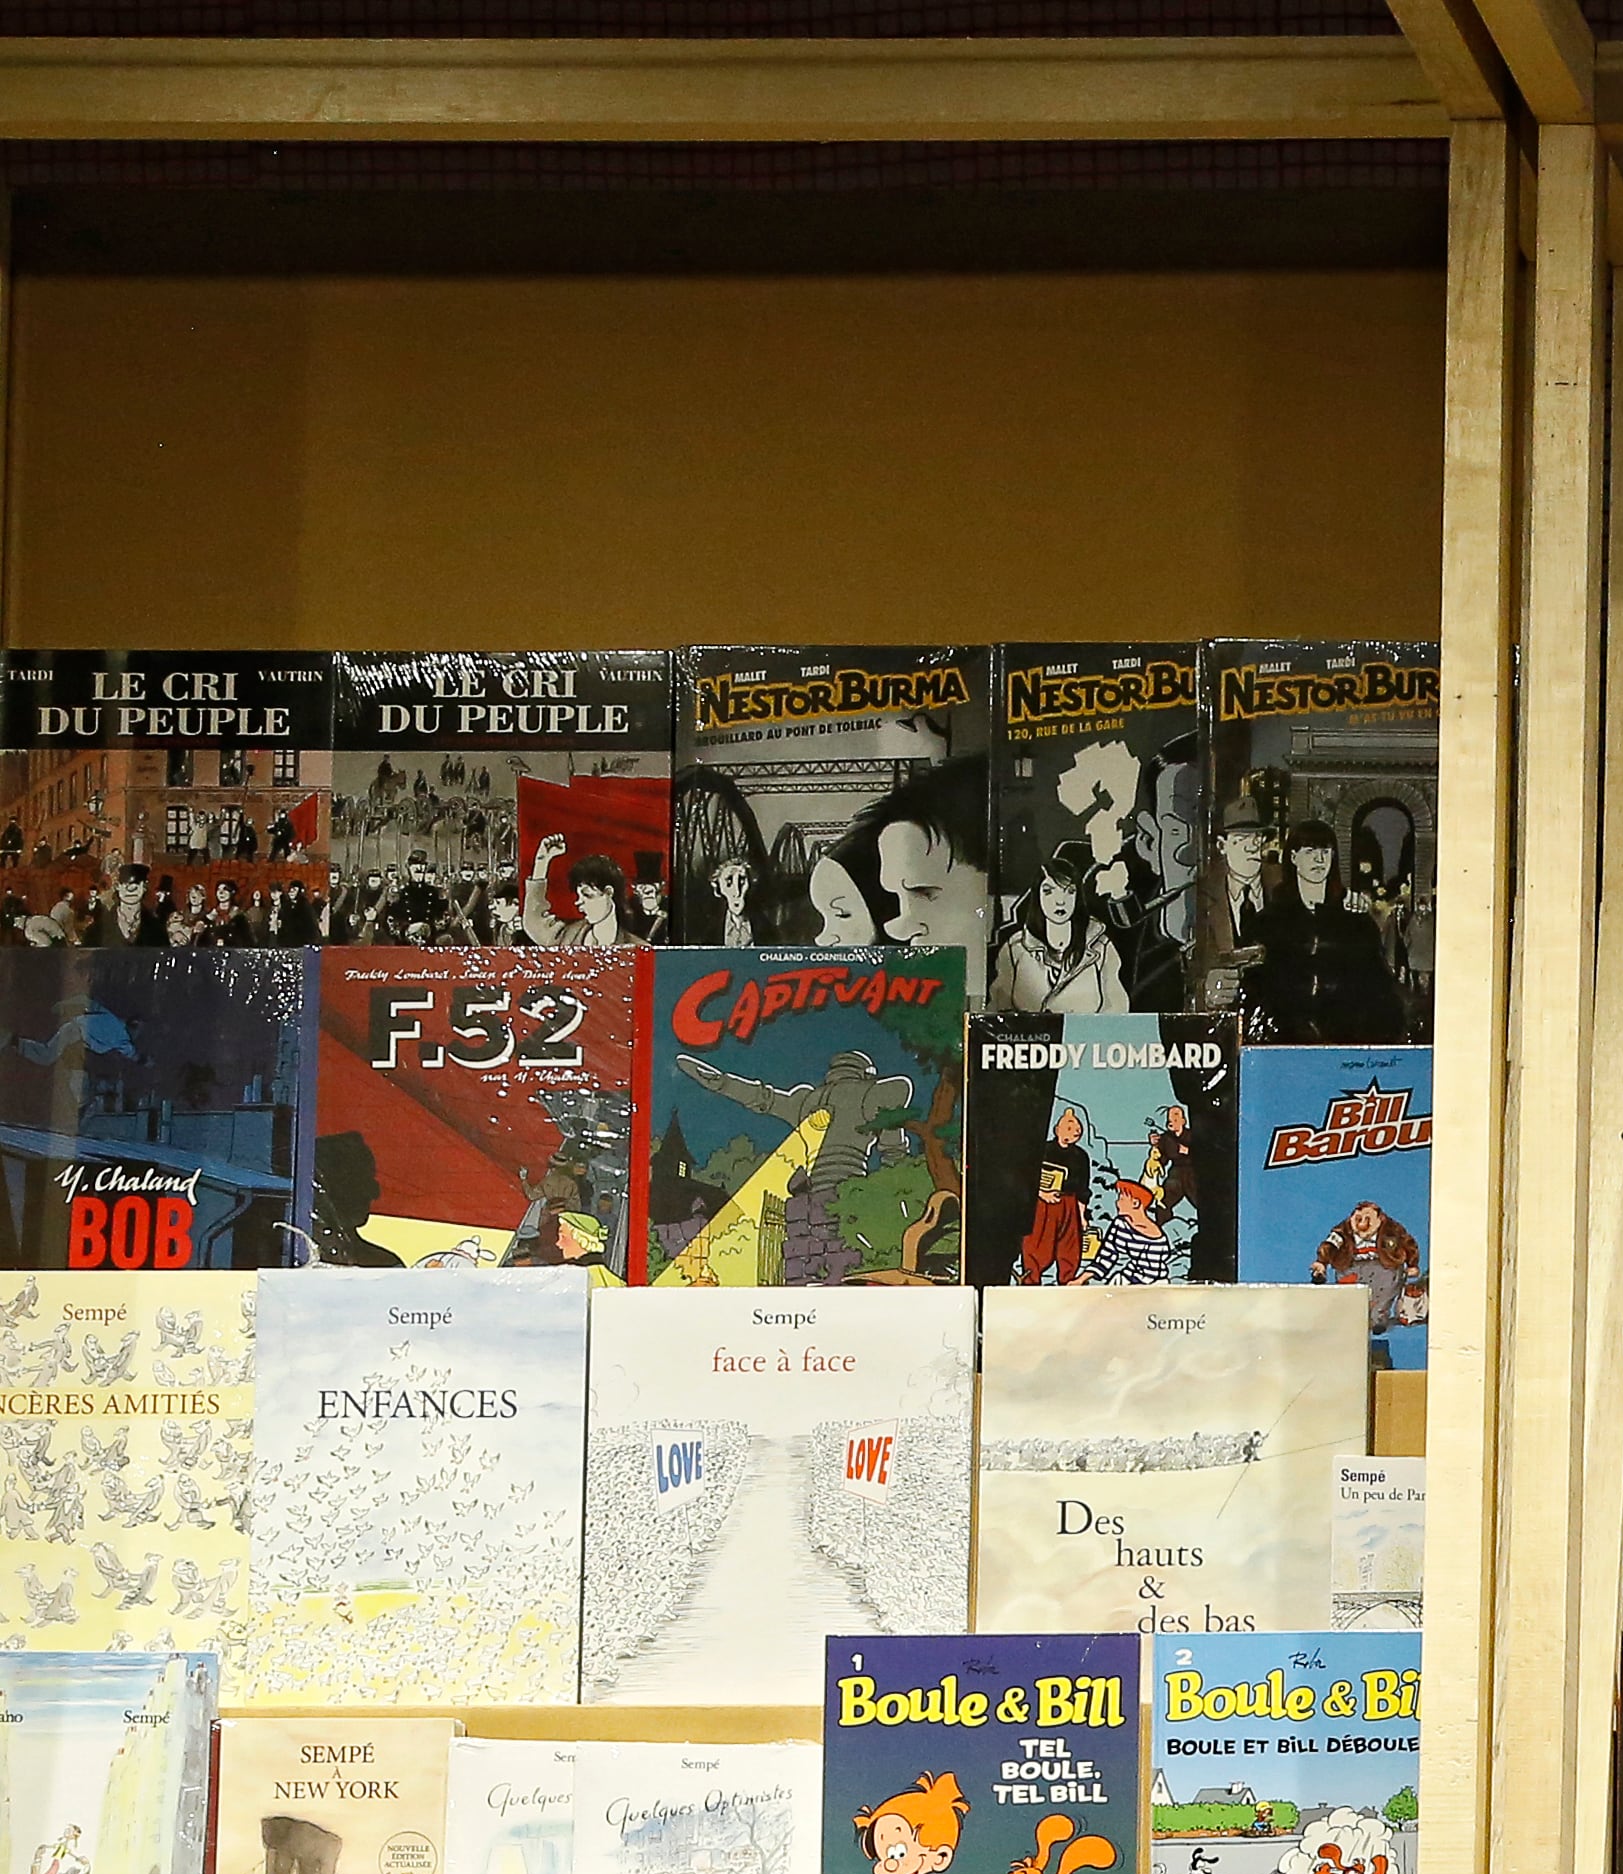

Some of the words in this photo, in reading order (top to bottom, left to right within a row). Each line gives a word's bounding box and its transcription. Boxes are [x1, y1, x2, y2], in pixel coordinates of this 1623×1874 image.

[7, 671, 53, 681] TARDI
[92, 673, 145, 700] LE
[163, 672, 239, 700] CRI
[258, 670, 323, 683] VAUTRIN
[38, 707, 103, 735] DU
[119, 706, 290, 736] PEUPLE
[380, 704, 442, 734] DU
[458, 704, 628, 734] PEUPLE
[981, 1043, 1087, 1069] FREDDY
[1092, 1042, 1221, 1069] LOMBARD
[67, 1196, 194, 1268] BOB
[62, 1304, 127, 1324] Sempé
[388, 1307, 452, 1328] Sempé
[752, 1310, 816, 1328] Sempé
[1146, 1314, 1206, 1333] Sempé
[712, 1348, 766, 1374] face
[778, 1348, 792, 1371] à
[803, 1348, 856, 1372] face
[103, 1394, 219, 1415] AMITIÉS
[319, 1389, 517, 1419] ENFANCES
[655, 1442, 704, 1494] LOVE
[846, 1437, 891, 1489] LOVE
[1340, 1469, 1386, 1485] Sempé
[1056, 1502, 1124, 1536] Des
[1115, 1540, 1203, 1567] hauts
[1166, 1670, 1314, 1721] Boule
[123, 1710, 170, 1727] Sempé
[300, 1745, 374, 1764] SEMPÉ
[1019, 1738, 1071, 1759] TEL
[1001, 1760, 1101, 1781] BOULE,
[274, 1781, 325, 1799] NEW
[332, 1781, 399, 1799] YORK
